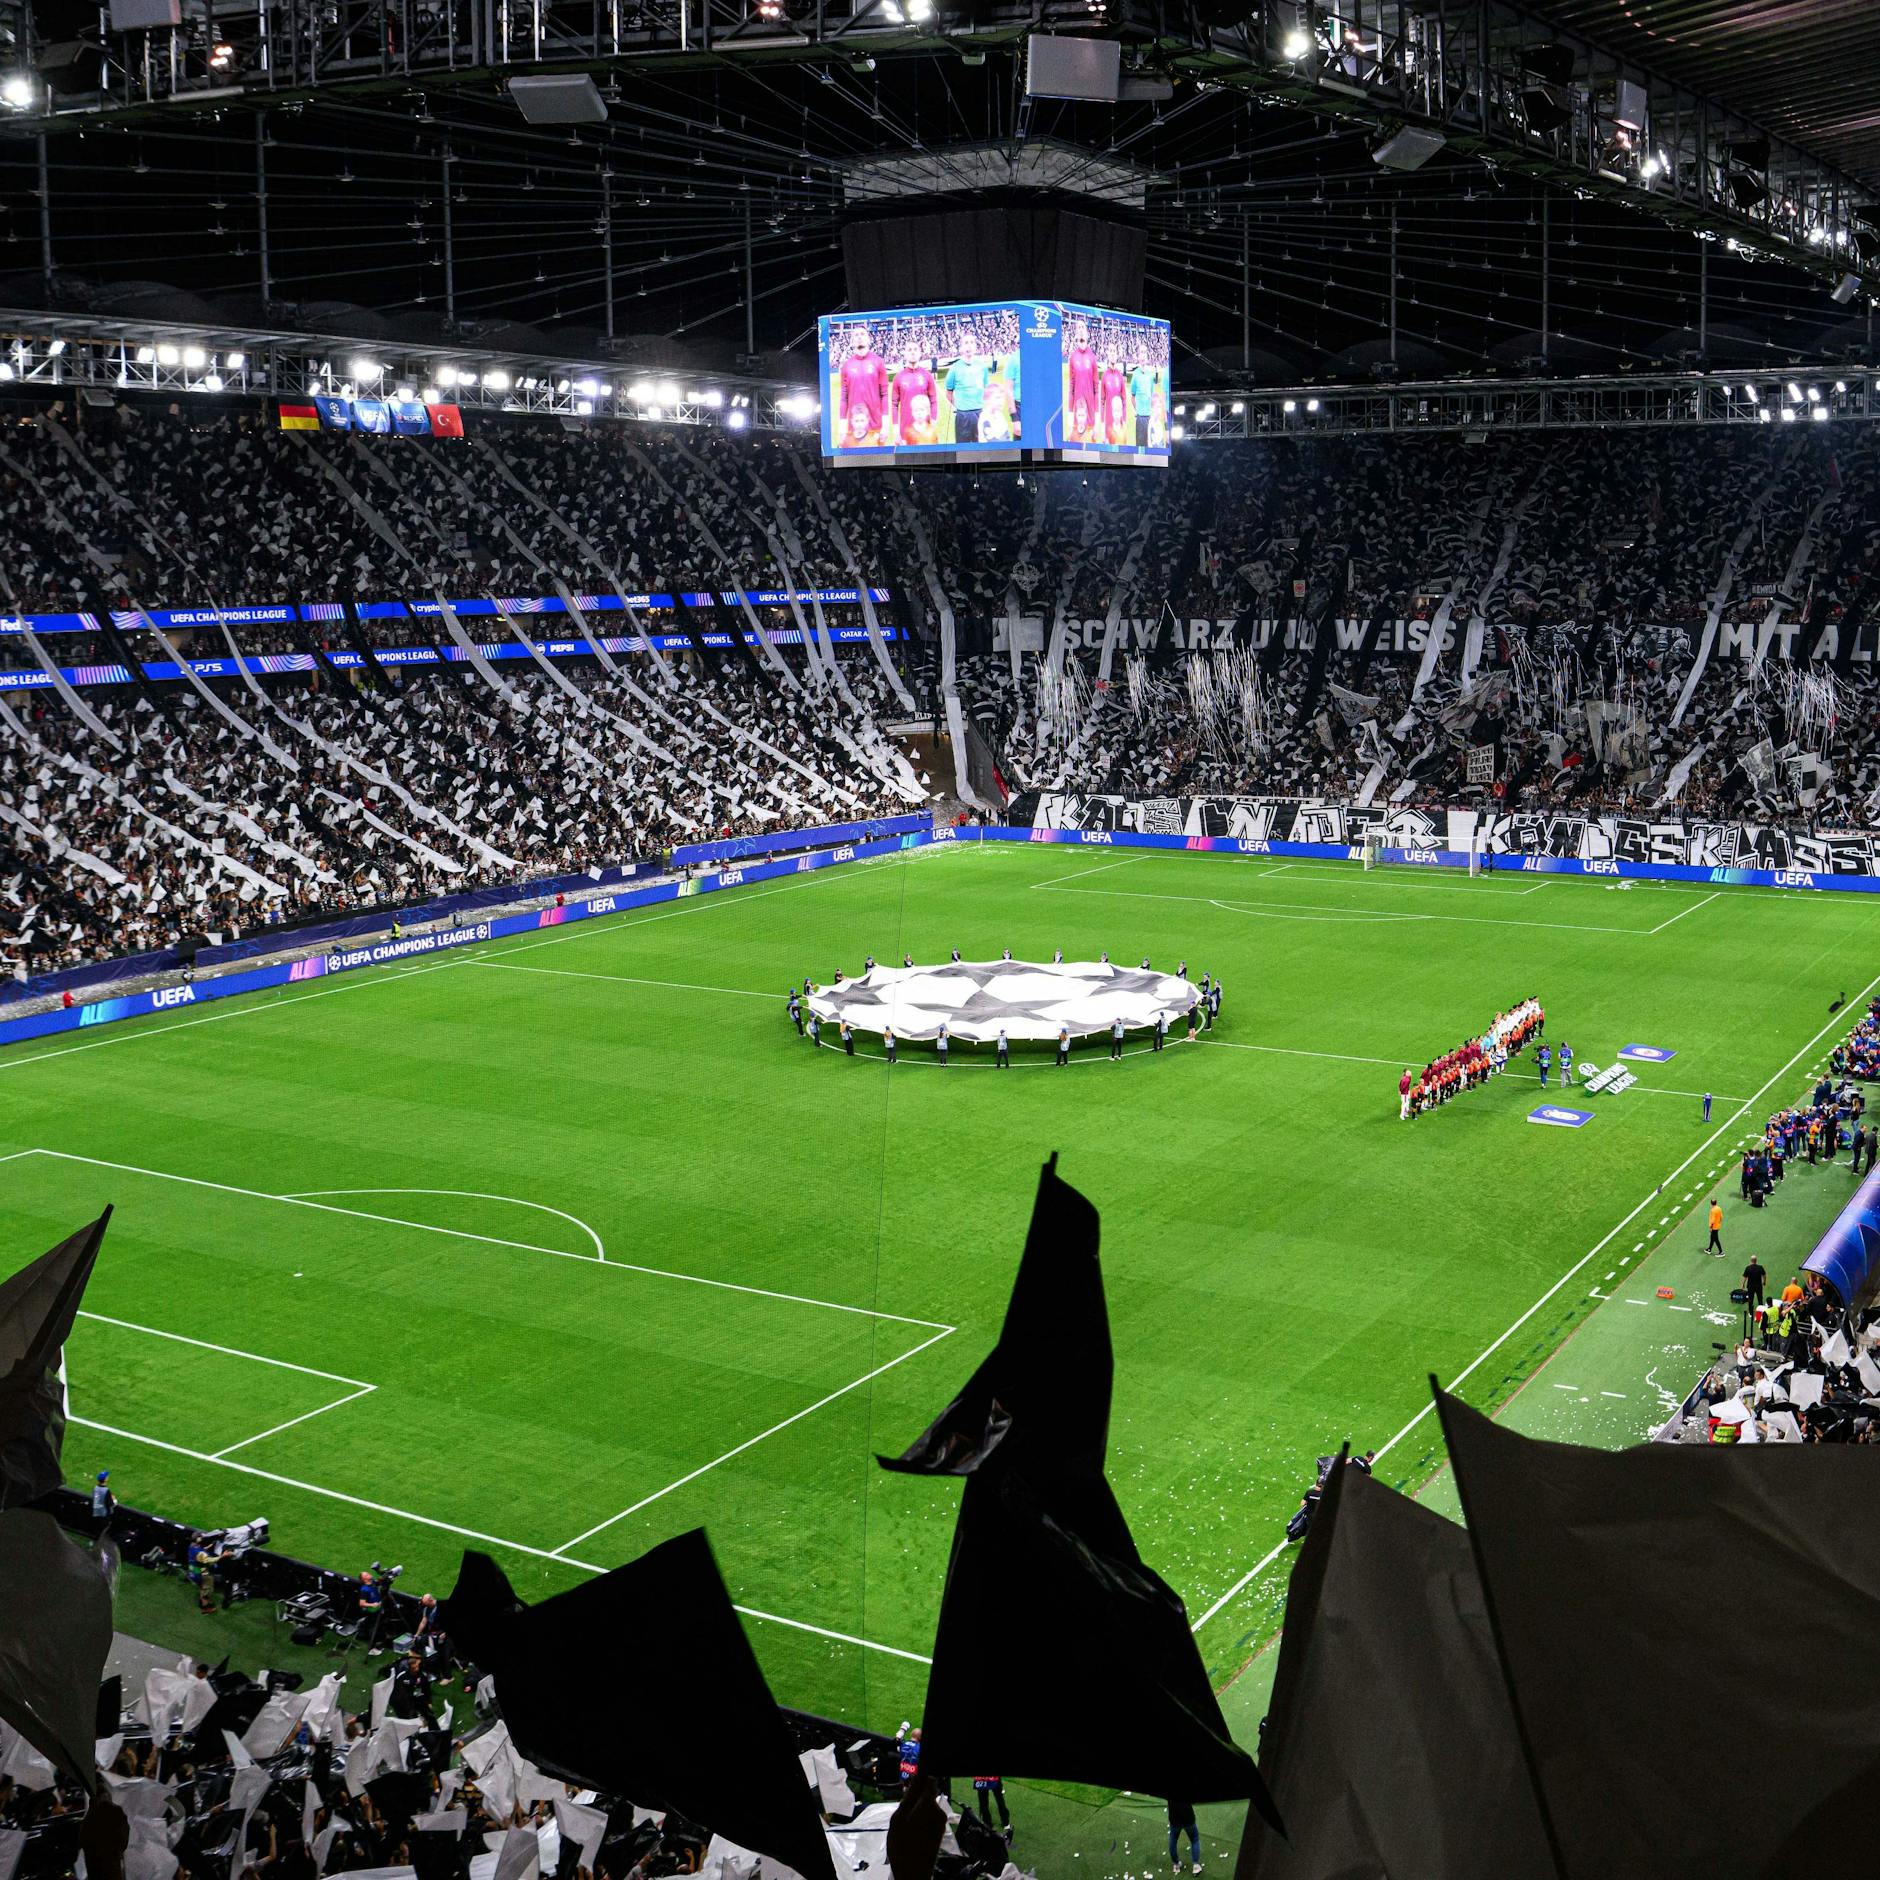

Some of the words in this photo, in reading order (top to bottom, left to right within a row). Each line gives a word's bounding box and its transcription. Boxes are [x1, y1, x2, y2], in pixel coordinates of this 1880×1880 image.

[758, 594, 778, 602] UEFA
[779, 592, 824, 601] CHMPIOS
[826, 592, 857, 600] LEAGUE
[417, 604, 457, 613] crypto.m
[170, 613, 195, 623] UEFA
[252, 609, 287, 619] LEAGUE
[1335, 619, 1457, 651] WEISS
[550, 643, 575, 652] PEPSI
[1811, 624, 1880, 661] AL
[333, 655, 356, 665] UEFA
[357, 652, 407, 663] CMPIONS
[408, 651, 439, 661] LEAGU
[19, 673, 53, 684] LEAGU
[932, 828, 956, 840] UEFA
[1081, 831, 1112, 844] UEFA
[1238, 840, 1271, 852] UEFA
[1475, 813, 1880, 876] KÖNIGSKLASS
[833, 846, 855, 861] UEFA
[1404, 850, 1438, 864] UEFA
[1583, 861, 1620, 875] UEFA
[719, 871, 743, 886] UEFA
[1775, 872, 1815, 887] UEFA
[587, 898, 616, 914] UEFA
[342, 949, 371, 967] UEFA
[373, 936, 435, 960] CHAMPIONS
[437, 928, 476, 946] LEAGUE
[152, 985, 196, 1008] UEFA
